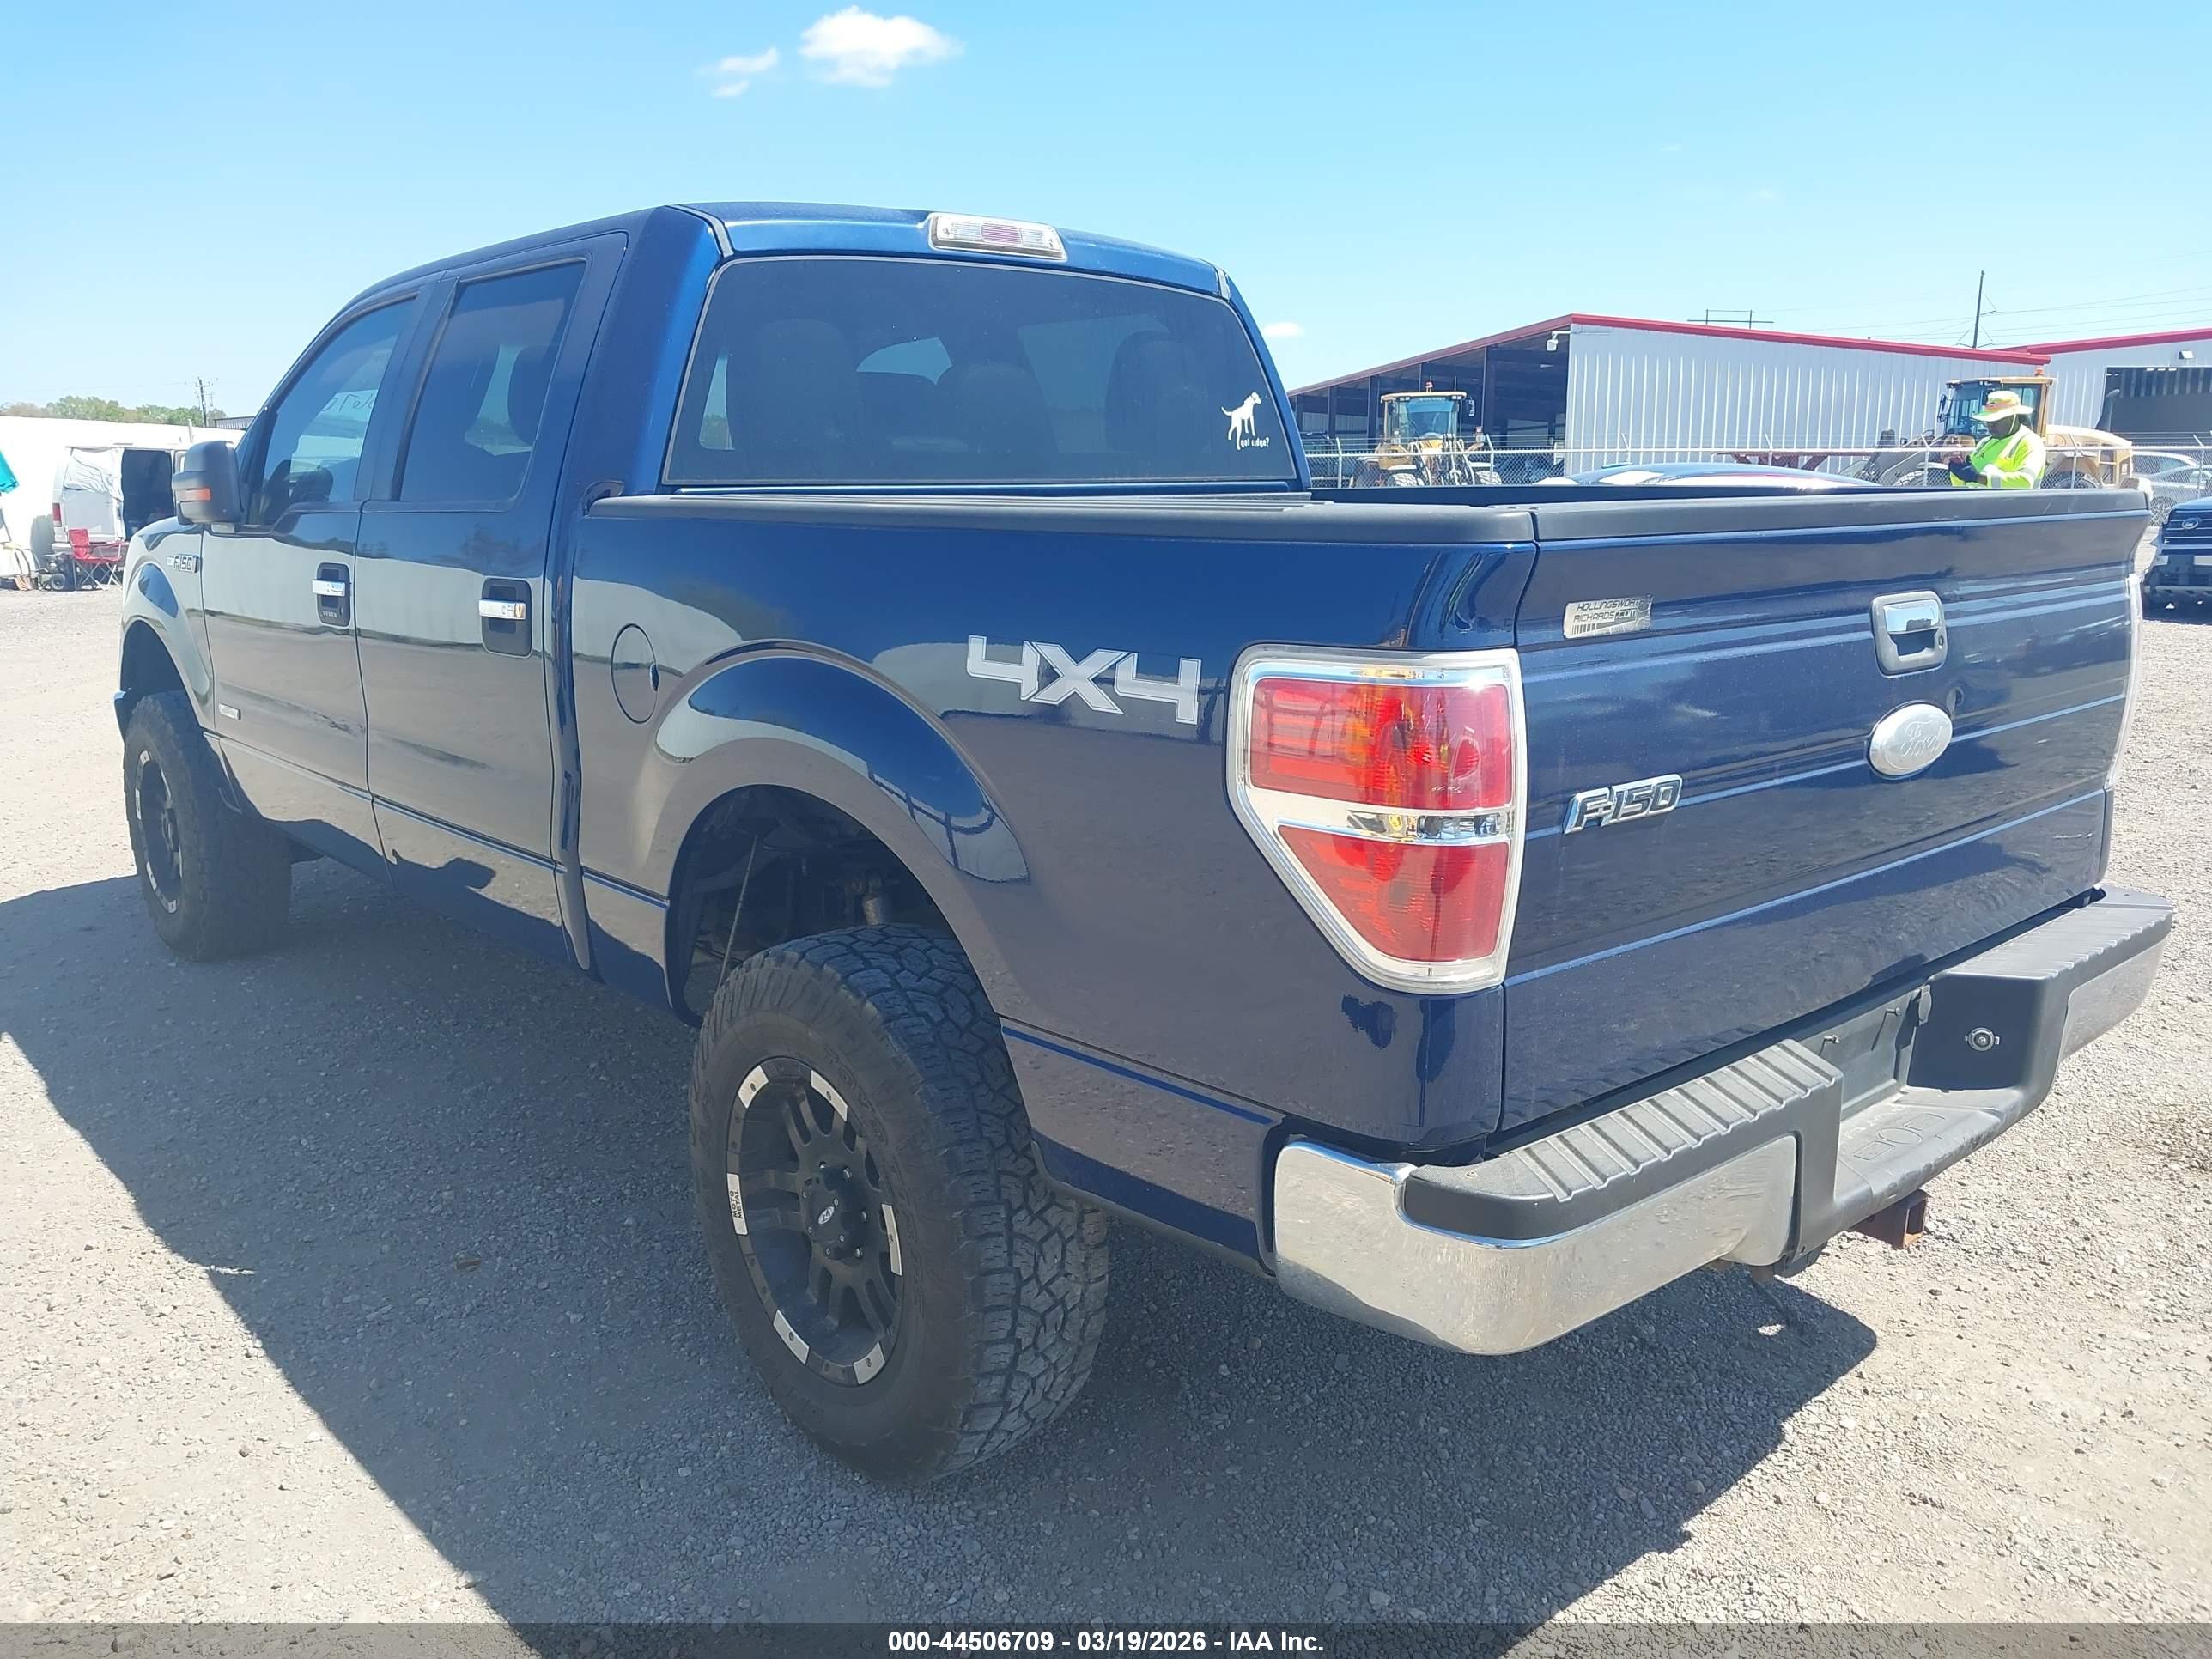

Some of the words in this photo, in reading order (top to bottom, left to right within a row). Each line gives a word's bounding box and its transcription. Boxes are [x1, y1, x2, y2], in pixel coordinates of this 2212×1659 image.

[1240, 438, 1250, 448] got
[1563, 773, 1683, 835] F-150
[729, 1190, 738, 1218] MOTO
[734, 1188, 743, 1219] METAL
